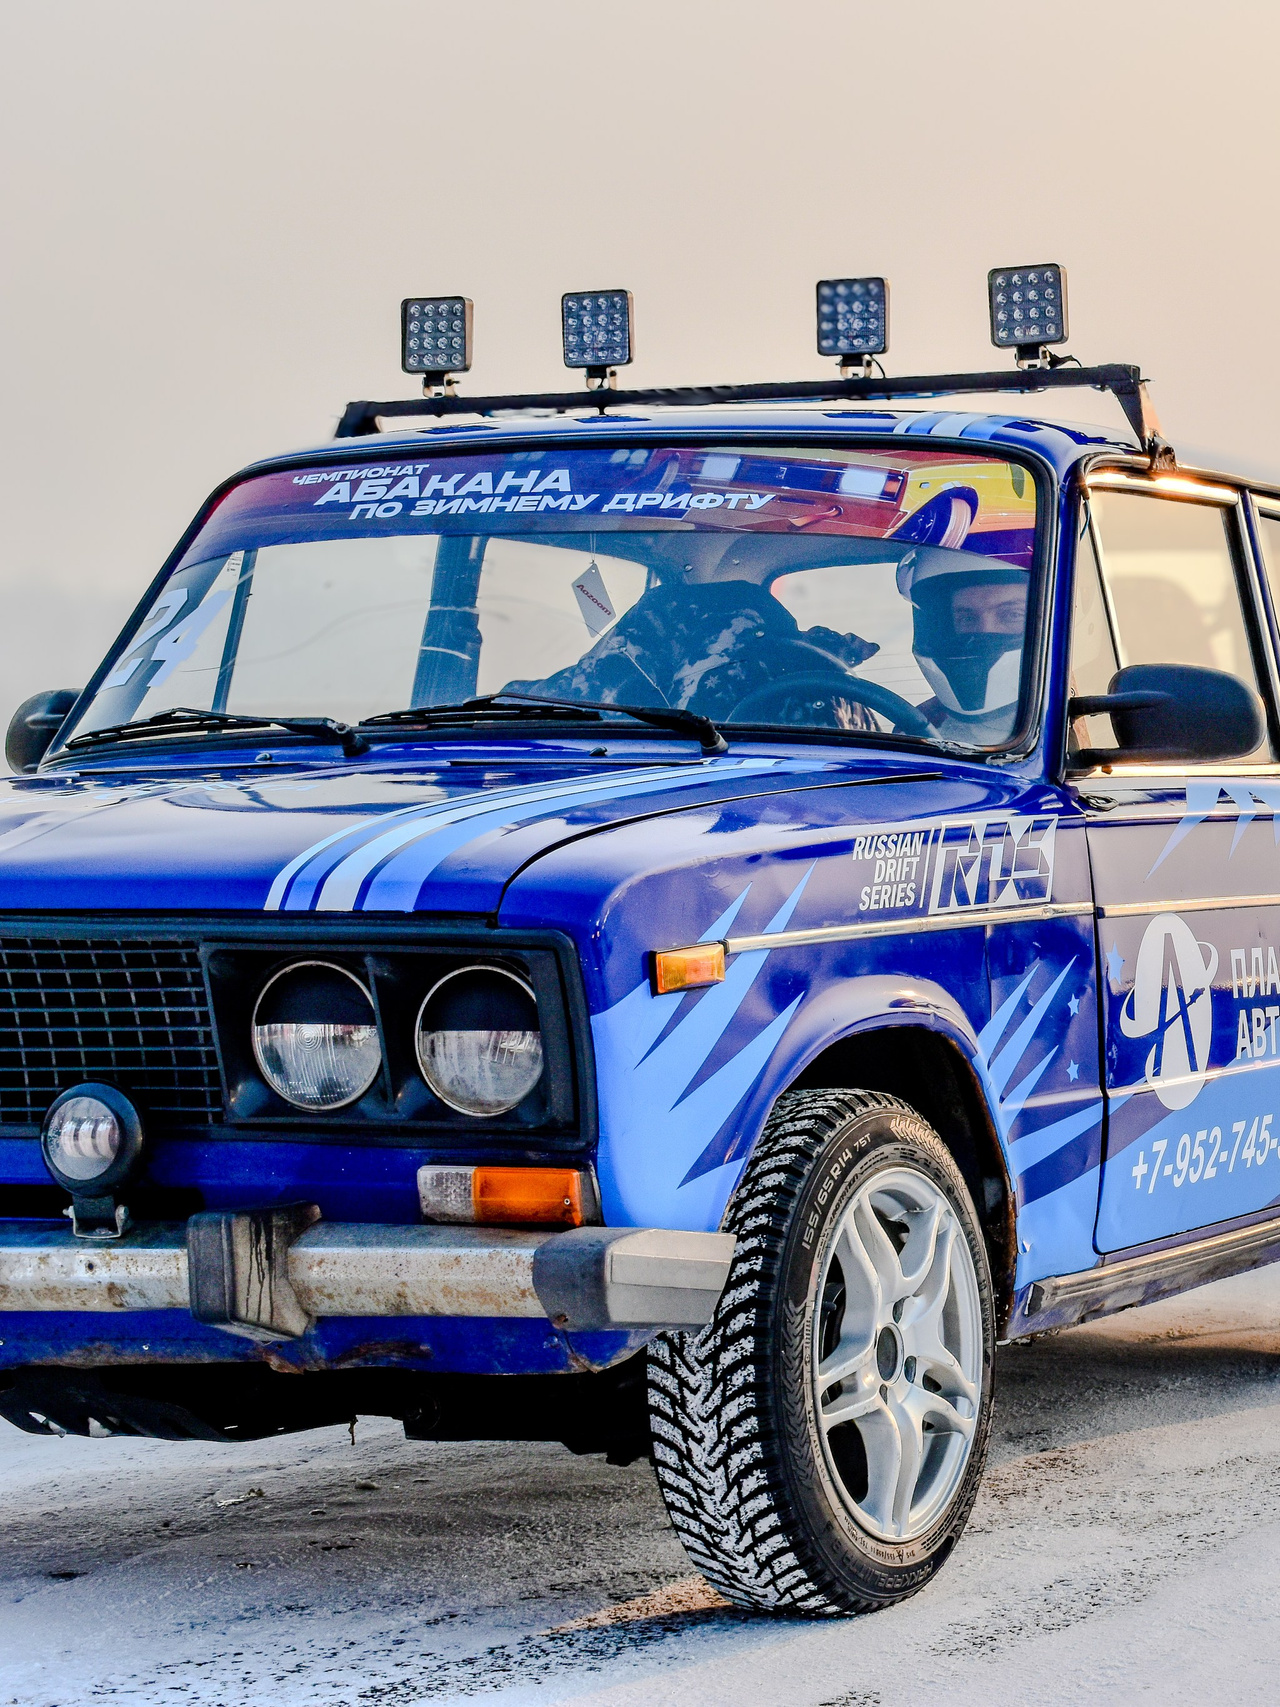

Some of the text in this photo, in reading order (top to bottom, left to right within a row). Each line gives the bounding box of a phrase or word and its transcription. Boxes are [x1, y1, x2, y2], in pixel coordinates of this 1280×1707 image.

[292, 464, 430, 486] ЧЕМПИОНАТ
[313, 469, 572, 506] АБАКАНА
[348, 492, 777, 520] ПО ЗИМНЕМУ ДРИФТУ
[576, 584, 612, 616] Aozoom
[96, 588, 235, 693] 24
[852, 832, 925, 861] RUSSIAN
[873, 857, 920, 884] DRIFT
[859, 882, 916, 911] SERIES
